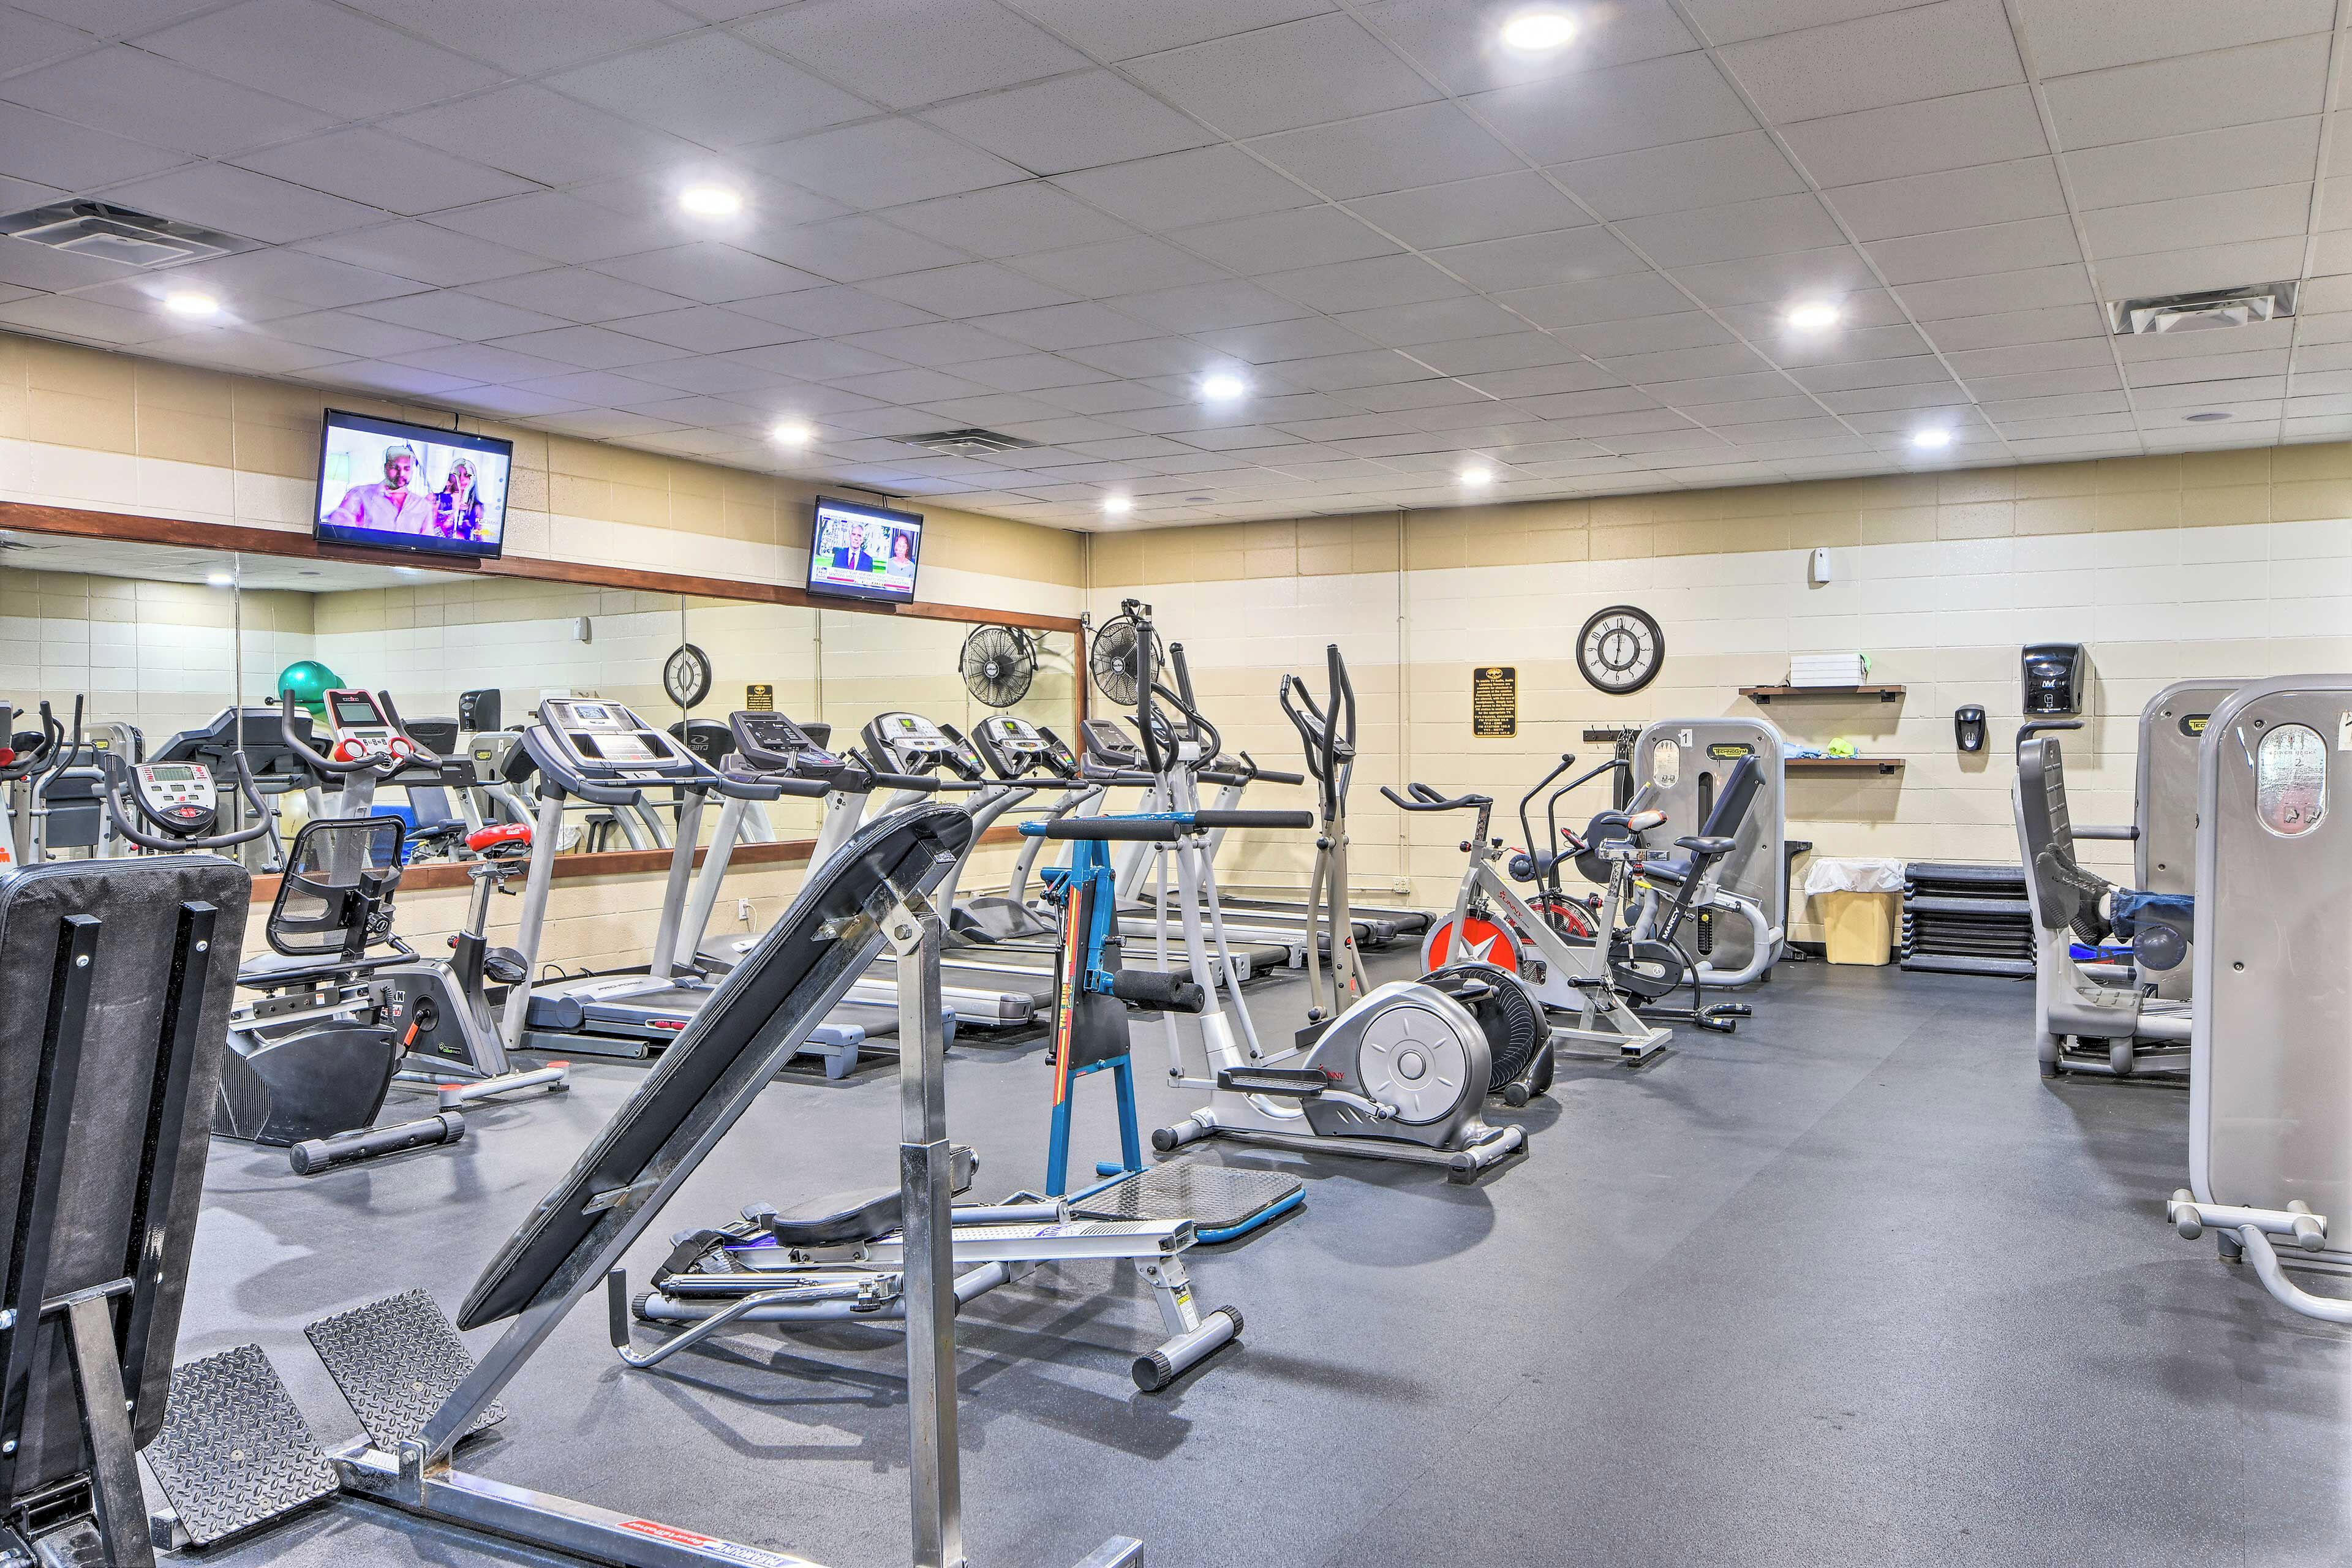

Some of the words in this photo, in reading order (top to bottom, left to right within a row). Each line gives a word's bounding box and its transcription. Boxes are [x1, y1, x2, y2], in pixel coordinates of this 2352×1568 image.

[1603, 622, 1610, 631] 11
[1591, 631, 1601, 641] 10
[1602, 669, 1608, 677] 7
[1615, 671, 1619, 681] 6
[1683, 733, 1687, 744] 1
[1499, 891, 1523, 918] SUNNY
[1662, 907, 1679, 940] MARCY
[1327, 1071, 1344, 1080] NNY
[714, 1542, 784, 1567] PARAMOUNT
